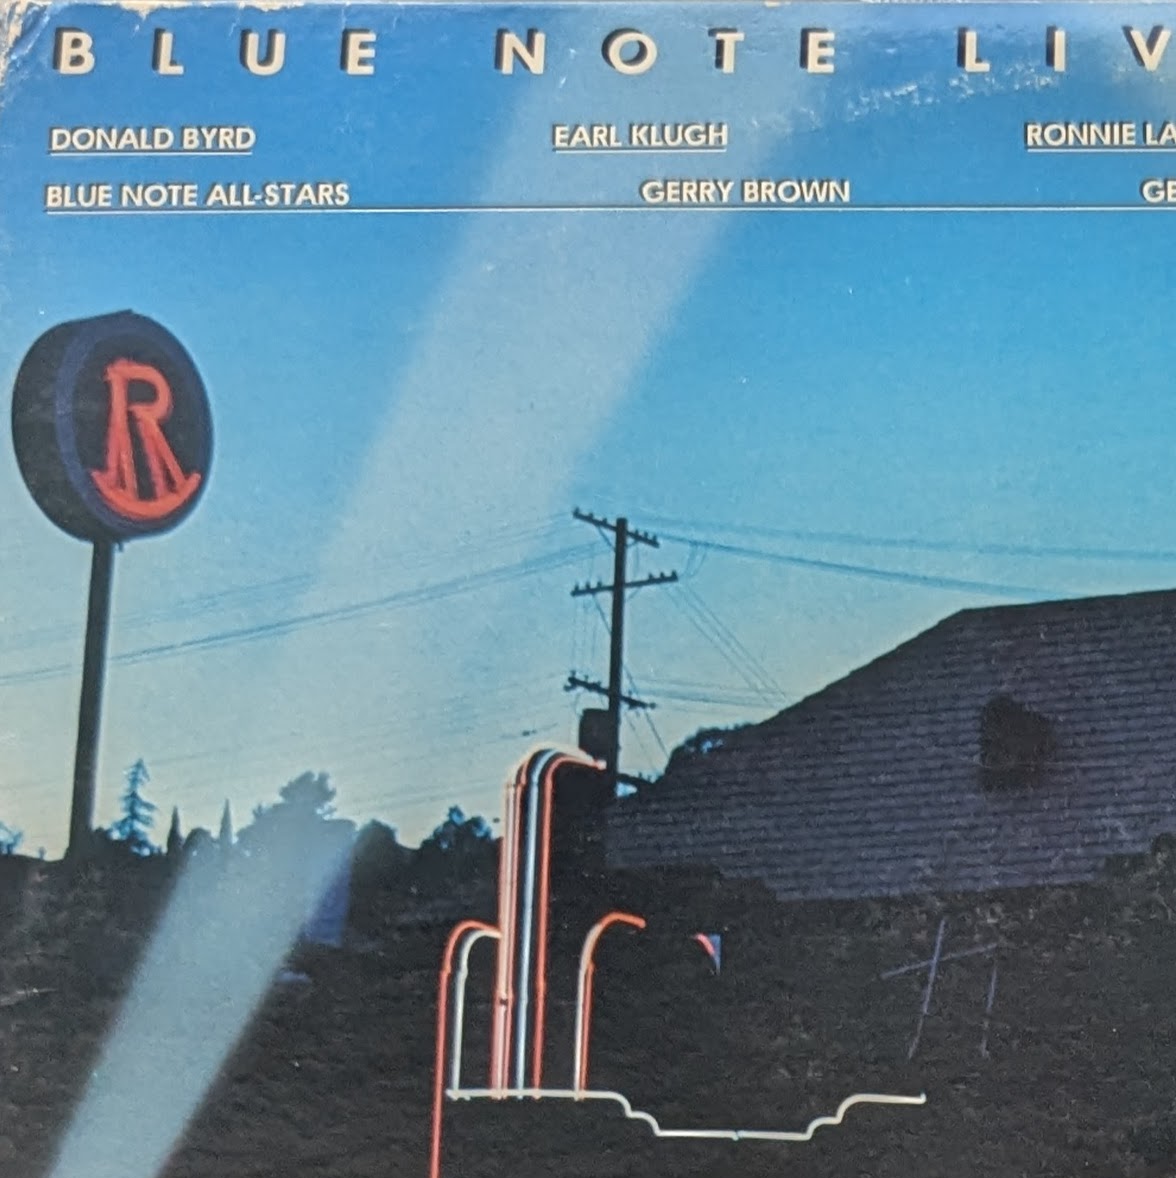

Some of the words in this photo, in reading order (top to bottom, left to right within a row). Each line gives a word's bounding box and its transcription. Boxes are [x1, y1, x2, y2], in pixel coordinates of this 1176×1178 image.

[54, 27, 376, 76] BLUE
[496, 27, 836, 76] NOTE
[50, 127, 174, 150] DONALD
[182, 127, 256, 150] BYRD
[553, 124, 622, 147] EARL
[630, 124, 729, 147] KLUGH
[1025, 122, 1136, 147] RONNIE
[45, 184, 113, 208] BLUE
[121, 184, 198, 207] NOTE
[206, 183, 350, 207] ALL-STARS
[641, 179, 735, 204] GERRY
[743, 179, 850, 204] BROWN
